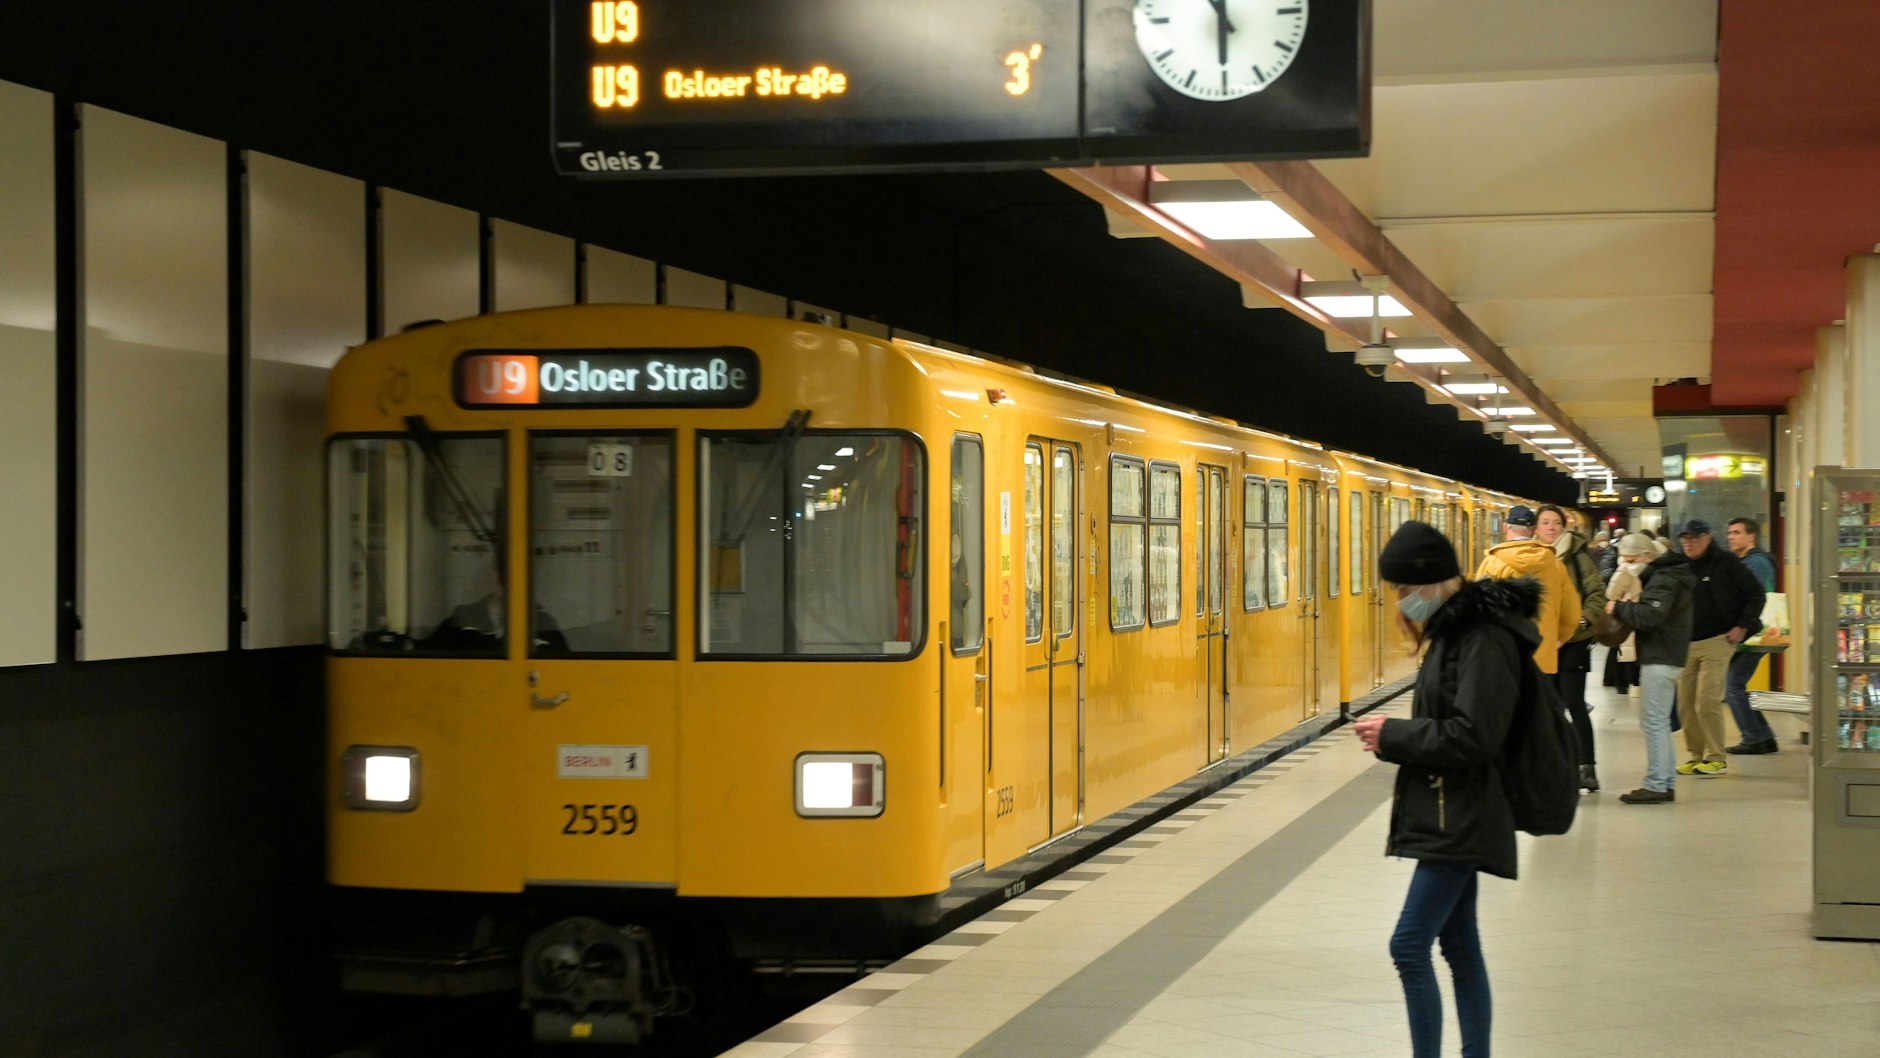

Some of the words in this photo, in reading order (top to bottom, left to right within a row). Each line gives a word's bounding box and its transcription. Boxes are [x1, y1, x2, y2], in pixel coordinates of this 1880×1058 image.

[592, 1, 639, 43] U9
[592, 66, 639, 107] U9
[664, 70, 751, 98] Osloer
[755, 66, 846, 99] Straße
[580, 151, 642, 171] Gleis
[645, 151, 663, 170] 2
[477, 360, 527, 395] U9
[539, 360, 640, 393] Osloer
[646, 357, 747, 392] Straße
[565, 755, 612, 768] BERLIN
[996, 786, 1014, 818] 2559
[562, 804, 639, 835] 2559
